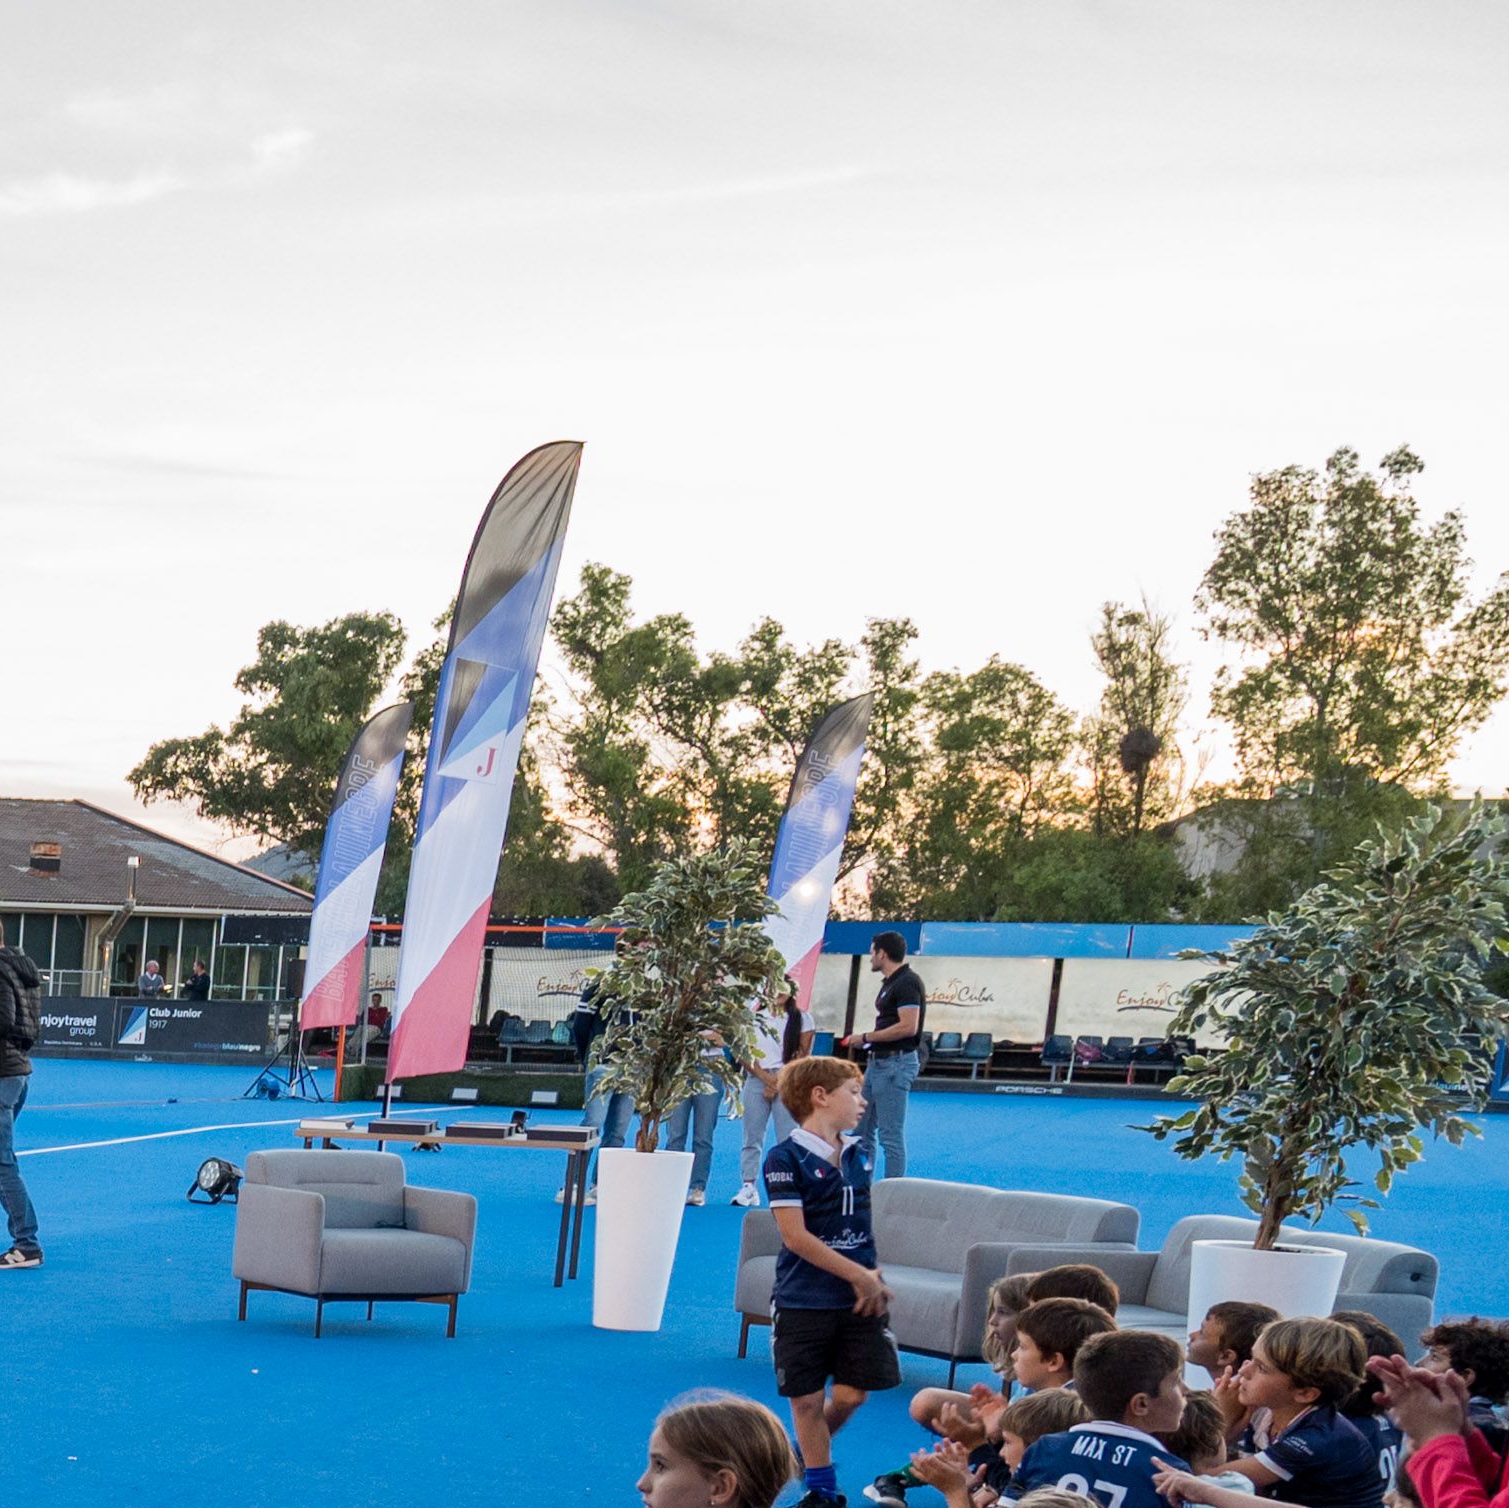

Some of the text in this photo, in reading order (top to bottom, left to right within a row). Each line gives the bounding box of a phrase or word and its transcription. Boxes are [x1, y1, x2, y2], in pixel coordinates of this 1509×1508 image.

[149, 1008, 203, 1019] Club Junior
[40, 1015, 97, 1030] njoytravel
[149, 1019, 168, 1029] 1917
[69, 1027, 96, 1037] group
[995, 1085, 1063, 1094] PORSCHE
[841, 1185, 854, 1217] 11
[1071, 1435, 1138, 1468] MAX ST
